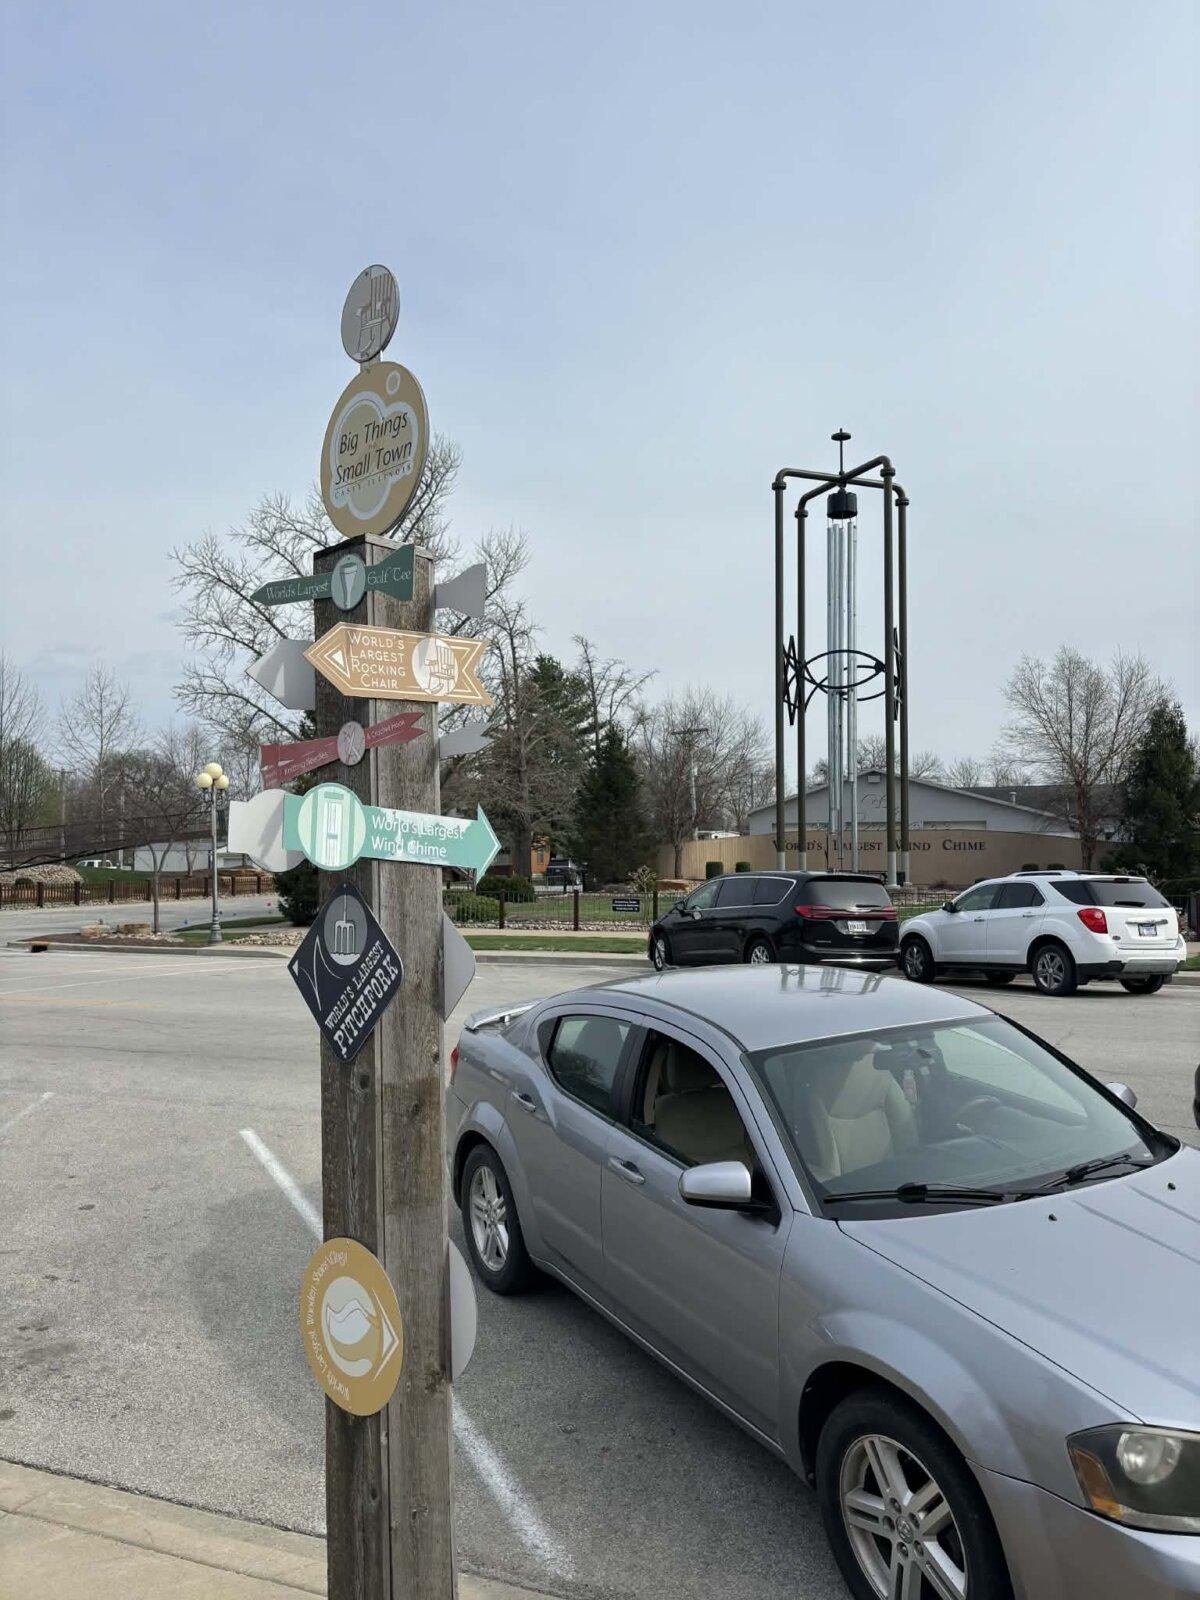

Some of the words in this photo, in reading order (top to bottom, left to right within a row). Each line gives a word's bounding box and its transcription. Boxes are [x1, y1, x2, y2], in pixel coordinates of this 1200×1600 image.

[339, 431, 359, 456] Big
[364, 412, 408, 443] Things
[335, 452, 371, 485] Small
[375, 441, 412, 470] Town
[297, 579, 329, 599] Largest
[367, 567, 391, 586] Golf
[392, 567, 411, 582] Tee
[347, 630, 405, 650] WORLD'S
[350, 644, 405, 663] LARGEST
[351, 658, 406, 677] ROCKING
[360, 673, 399, 689] CHAIR
[372, 815, 418, 834] World's
[418, 821, 464, 841] Largest
[371, 834, 404, 855] Wind
[407, 840, 447, 858] Chime
[942, 838, 986, 851] CHIME
[324, 986, 356, 1031] WORLD'S
[352, 940, 385, 989] LARGEST
[333, 953, 399, 1056] PITCHFORK
